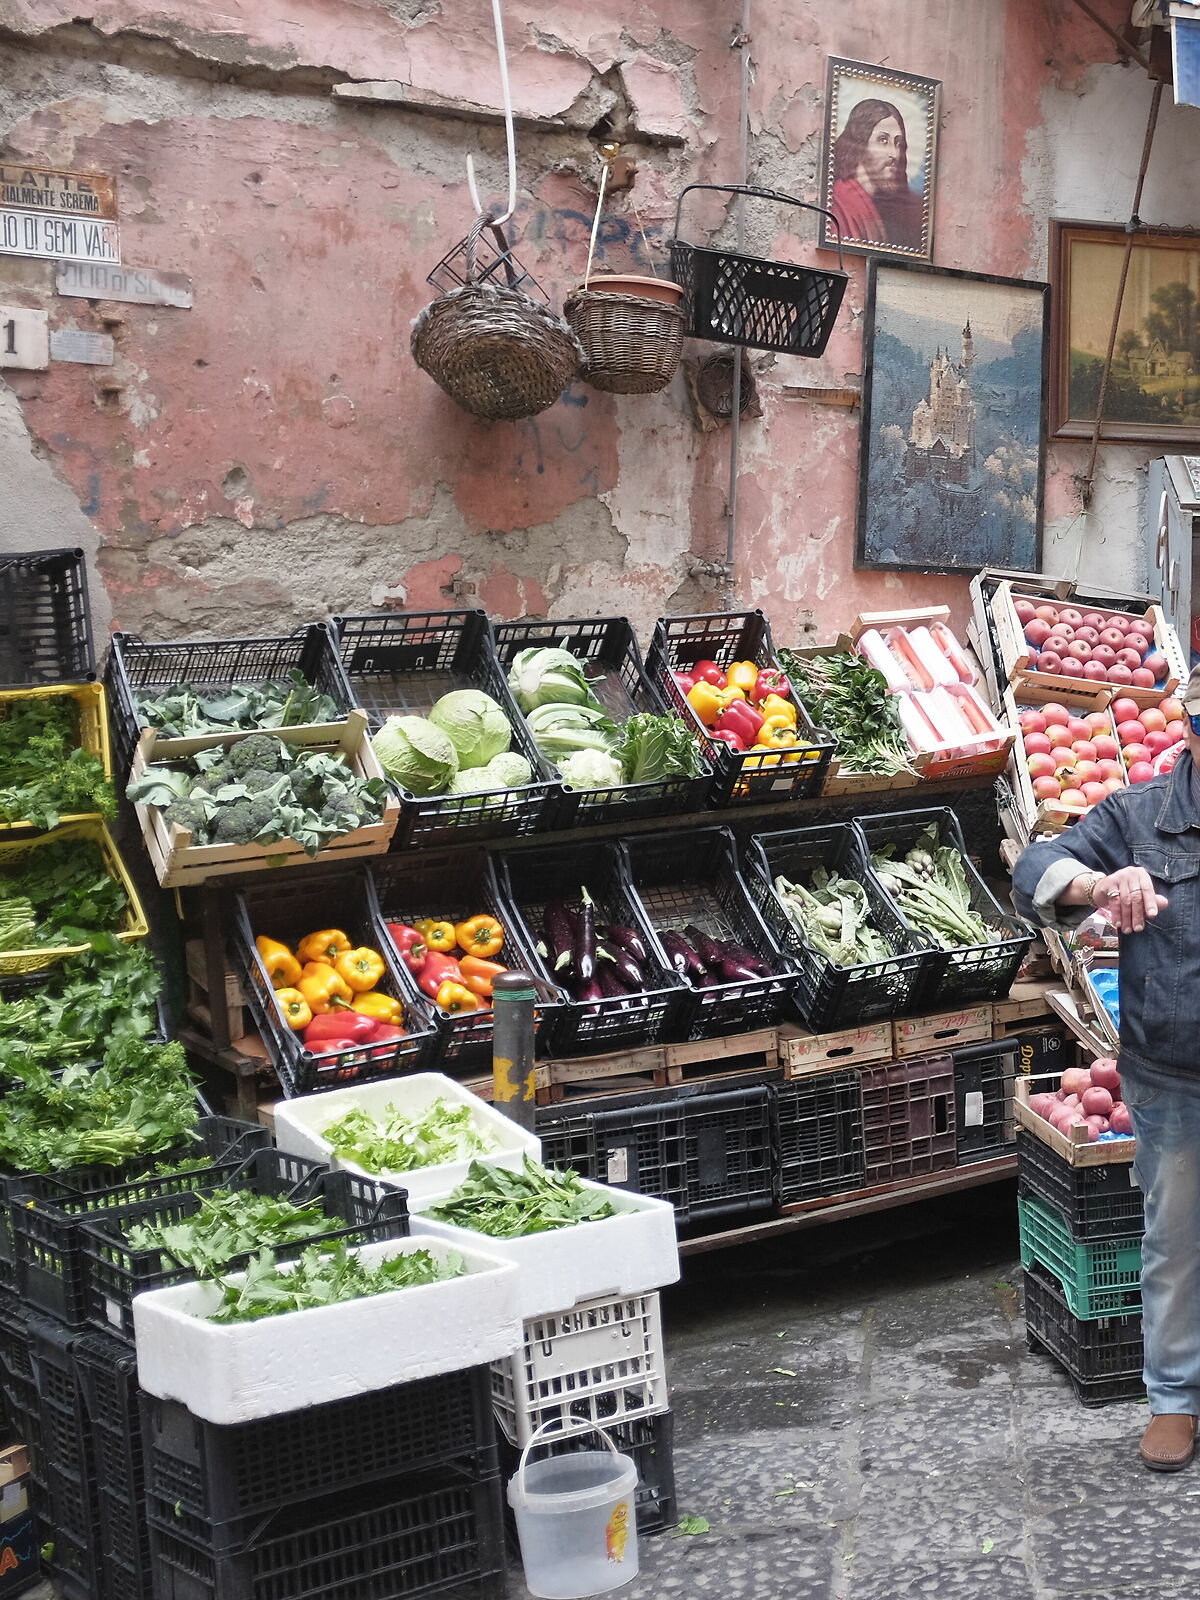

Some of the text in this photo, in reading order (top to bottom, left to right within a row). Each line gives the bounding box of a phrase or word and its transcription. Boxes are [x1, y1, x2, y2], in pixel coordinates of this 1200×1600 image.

[0, 167, 93, 193] LATTE
[0, 215, 18, 248] IO
[24, 217, 38, 250] DI
[45, 219, 77, 254] SEMI
